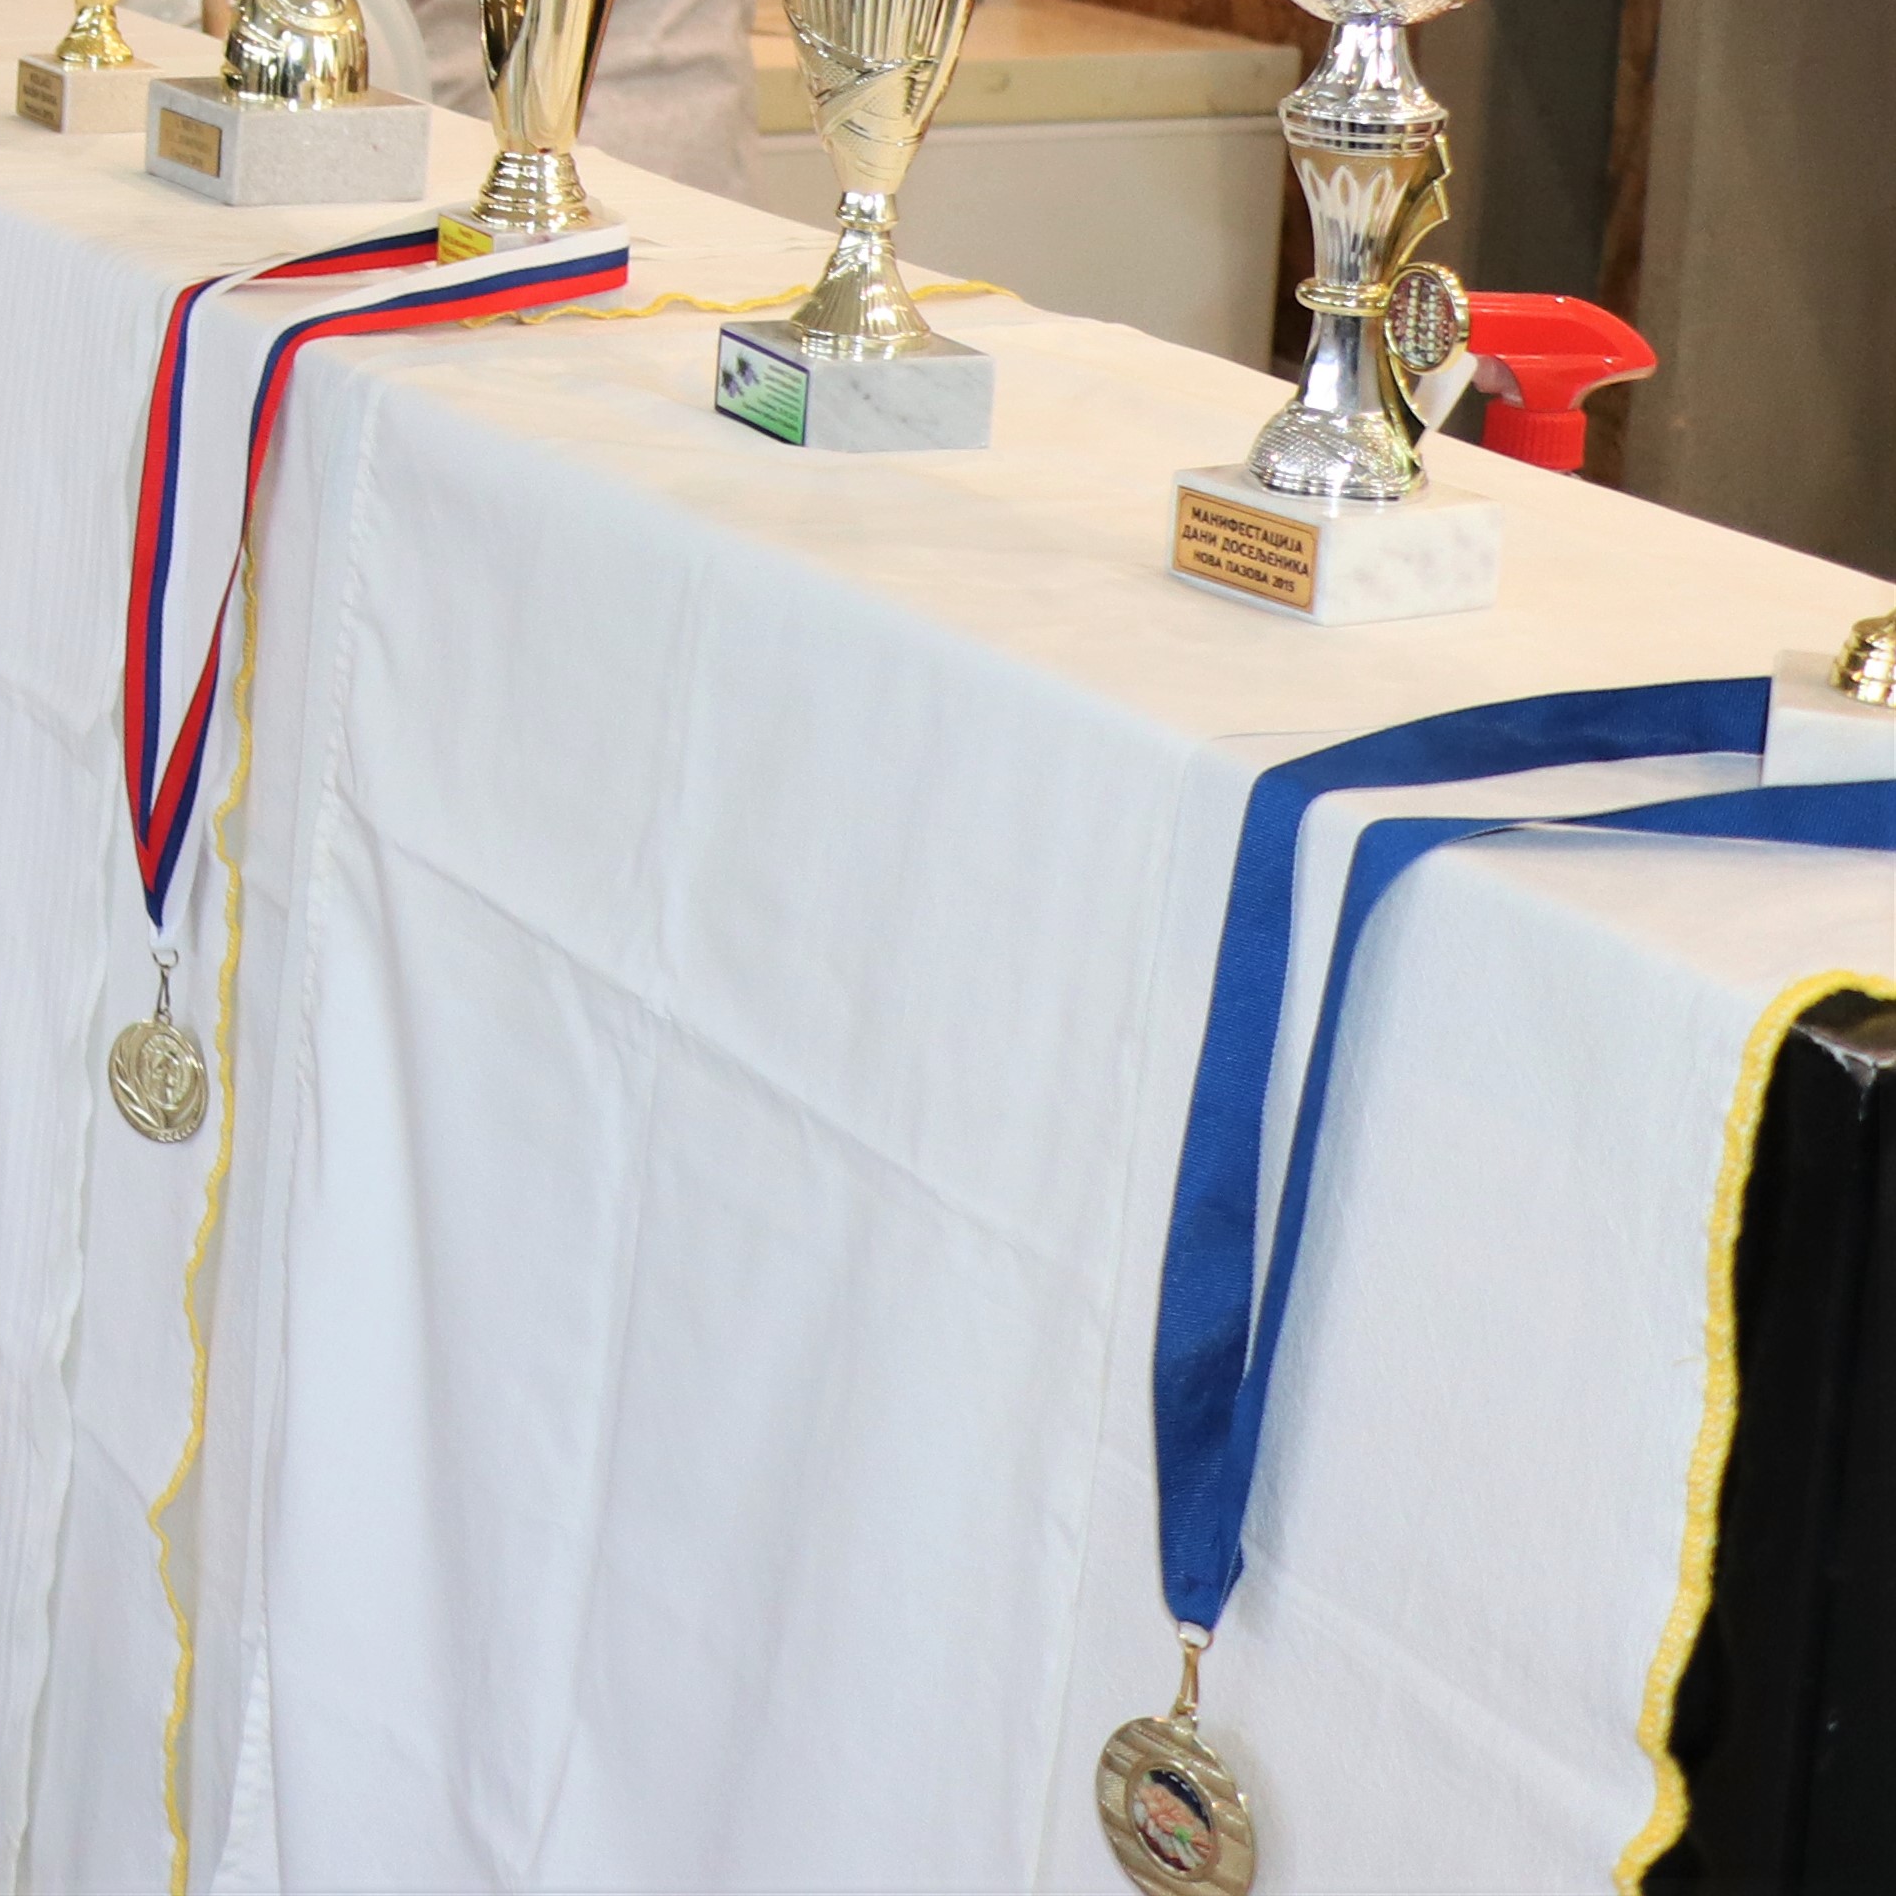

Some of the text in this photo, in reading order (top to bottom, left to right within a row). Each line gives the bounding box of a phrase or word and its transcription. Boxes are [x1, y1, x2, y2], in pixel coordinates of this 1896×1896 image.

[1182, 524, 1309, 577] ДАНИ ДОСЕЉЕНИКА
[1191, 506, 1303, 553] МАНИФЕСТАЦИЈА
[1193, 550, 1222, 568] НОВА
[1225, 561, 1268, 584] ПАЗОВА
